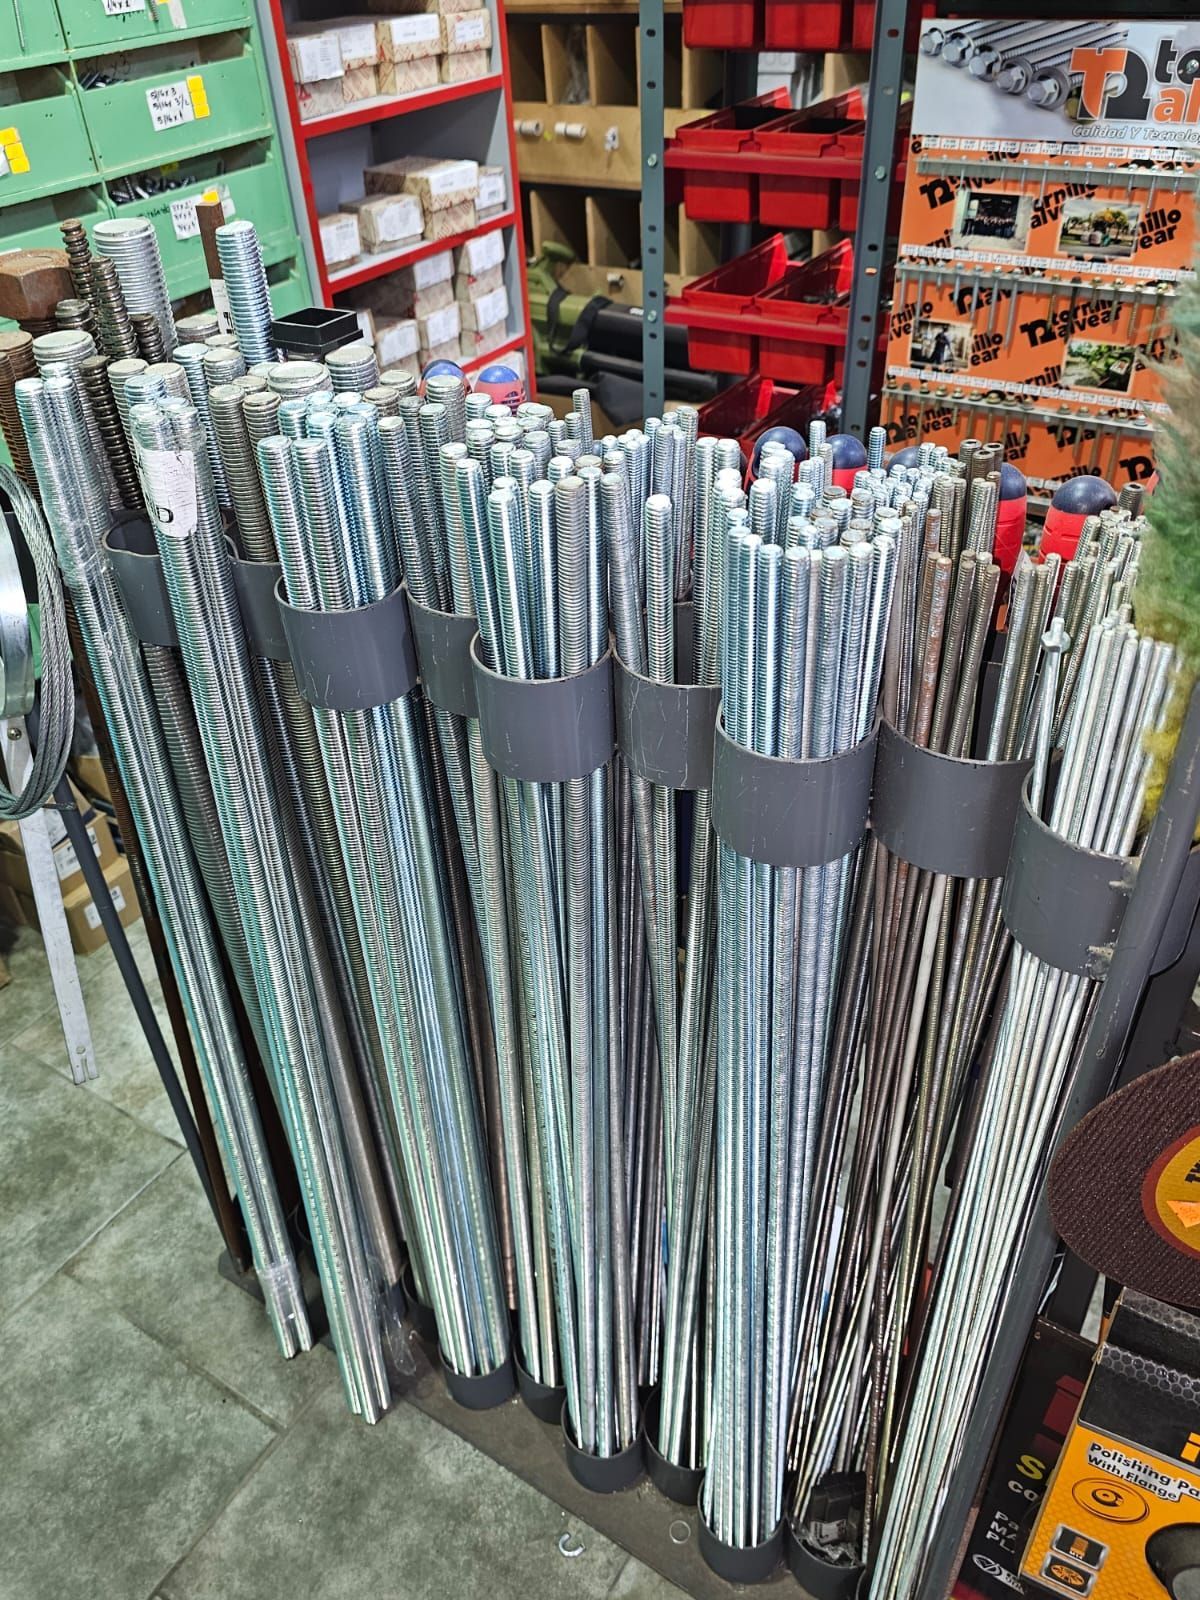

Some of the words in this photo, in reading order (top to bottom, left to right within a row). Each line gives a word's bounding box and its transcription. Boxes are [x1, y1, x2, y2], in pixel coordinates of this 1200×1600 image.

[1072, 124, 1127, 139] Calidad
[1130, 127, 1143, 140] Y
[1016, 1455, 1048, 1482] S
[1088, 1455, 1122, 1478] With
[1125, 1472, 1178, 1501] Flange
[1090, 1442, 1171, 1486] Polishing
